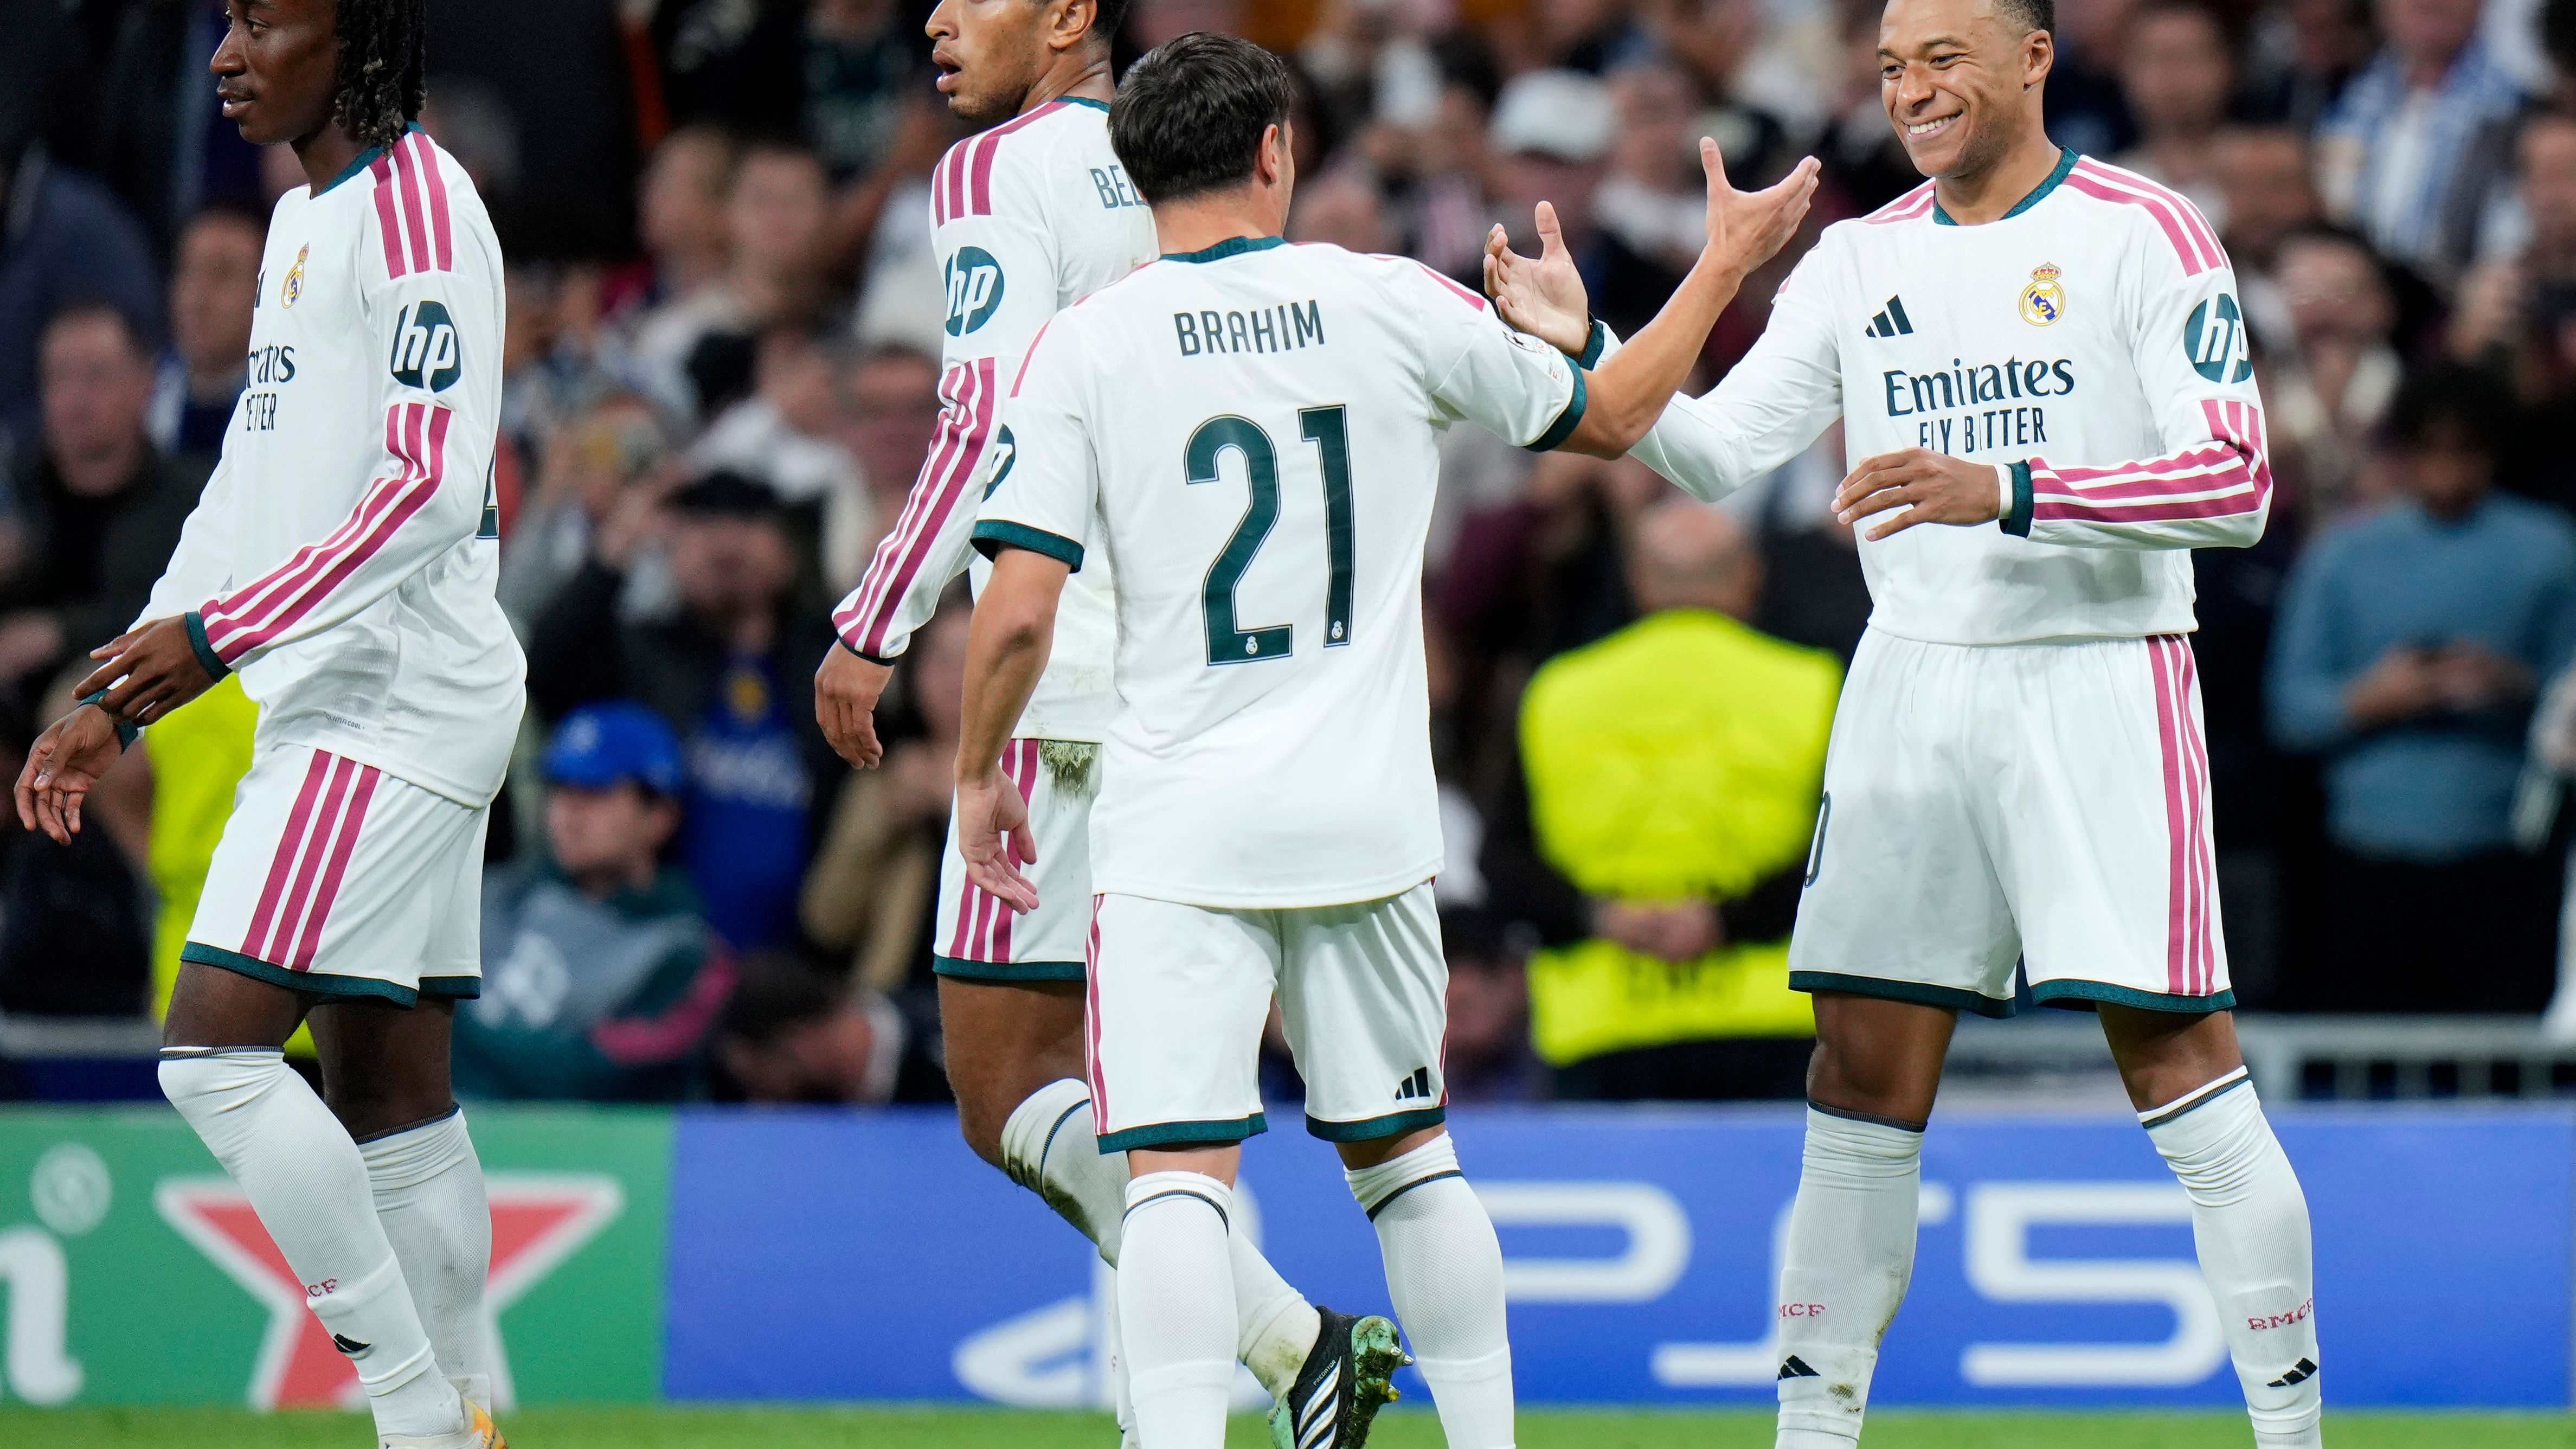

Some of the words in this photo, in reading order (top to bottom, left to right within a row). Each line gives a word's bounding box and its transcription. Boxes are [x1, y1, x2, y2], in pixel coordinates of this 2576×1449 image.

[946, 246, 1003, 336] hp
[1174, 300, 1324, 356] BRAHIM
[390, 300, 460, 393] hp
[2187, 293, 2251, 383] hp
[1883, 355, 2074, 416] Emirates
[1964, 407, 2047, 453] BTTER
[1184, 404, 1354, 666] 21
